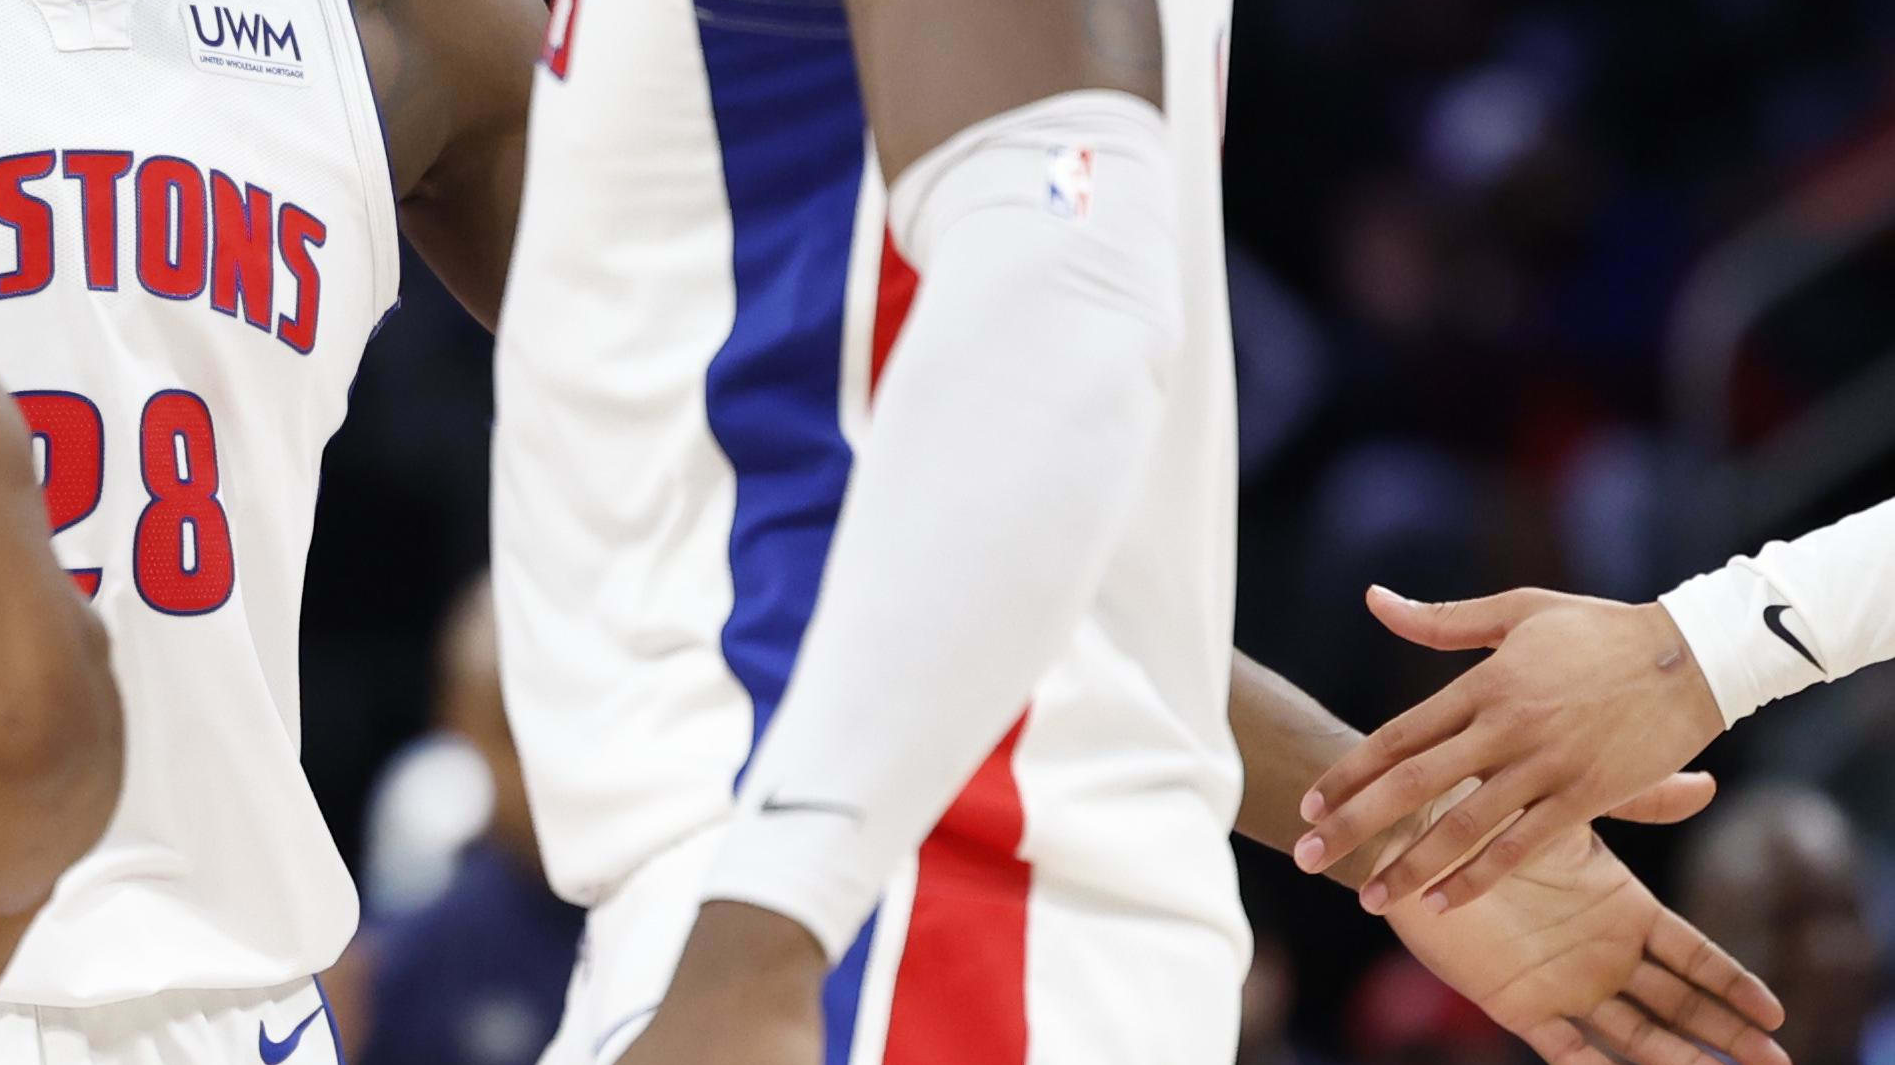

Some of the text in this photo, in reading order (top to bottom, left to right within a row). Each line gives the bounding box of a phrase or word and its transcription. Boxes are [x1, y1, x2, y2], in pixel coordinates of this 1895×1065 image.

[189, 4, 302, 62] UWM
[199, 55, 224, 66] UNITED
[226, 60, 264, 73] WHOLESALE
[7, 388, 235, 617] 28
